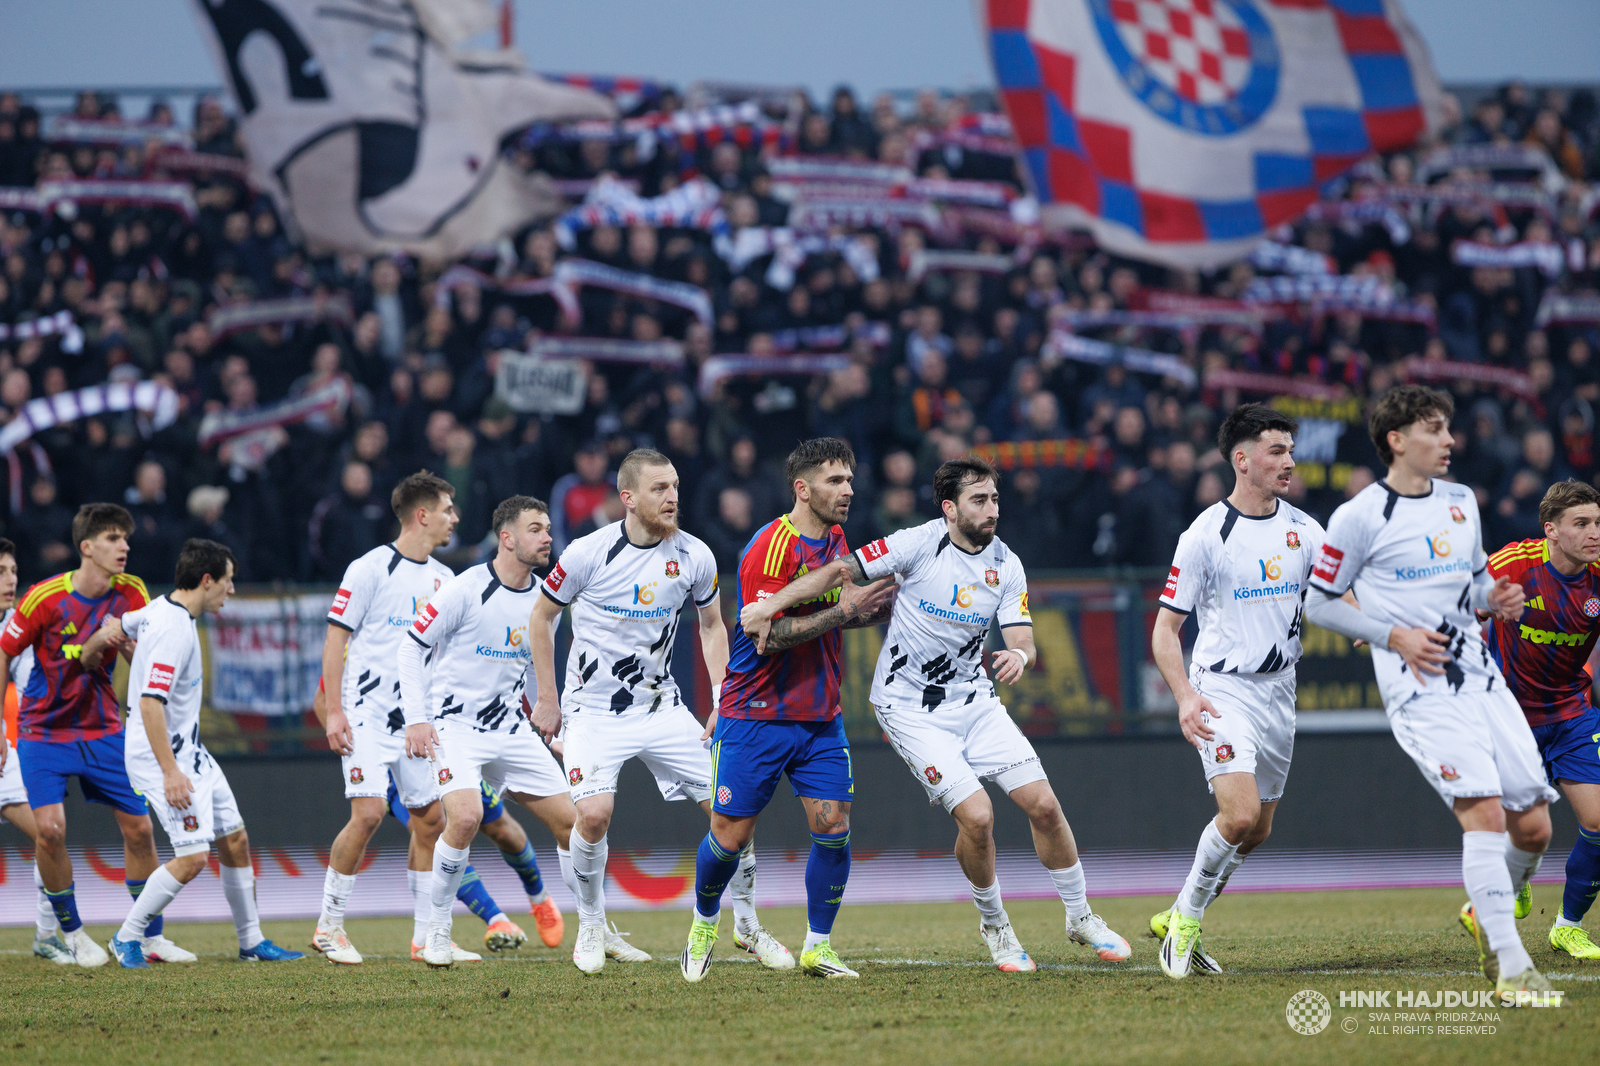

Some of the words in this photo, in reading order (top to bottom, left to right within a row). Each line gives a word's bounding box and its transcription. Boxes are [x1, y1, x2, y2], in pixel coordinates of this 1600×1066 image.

[756, 590, 774, 598] Sup
[1234, 581, 1300, 600] Kömmerling
[604, 604, 671, 618] Kömmerling
[919, 598, 990, 627] Kömmerling
[1519, 624, 1592, 646] TOMMY
